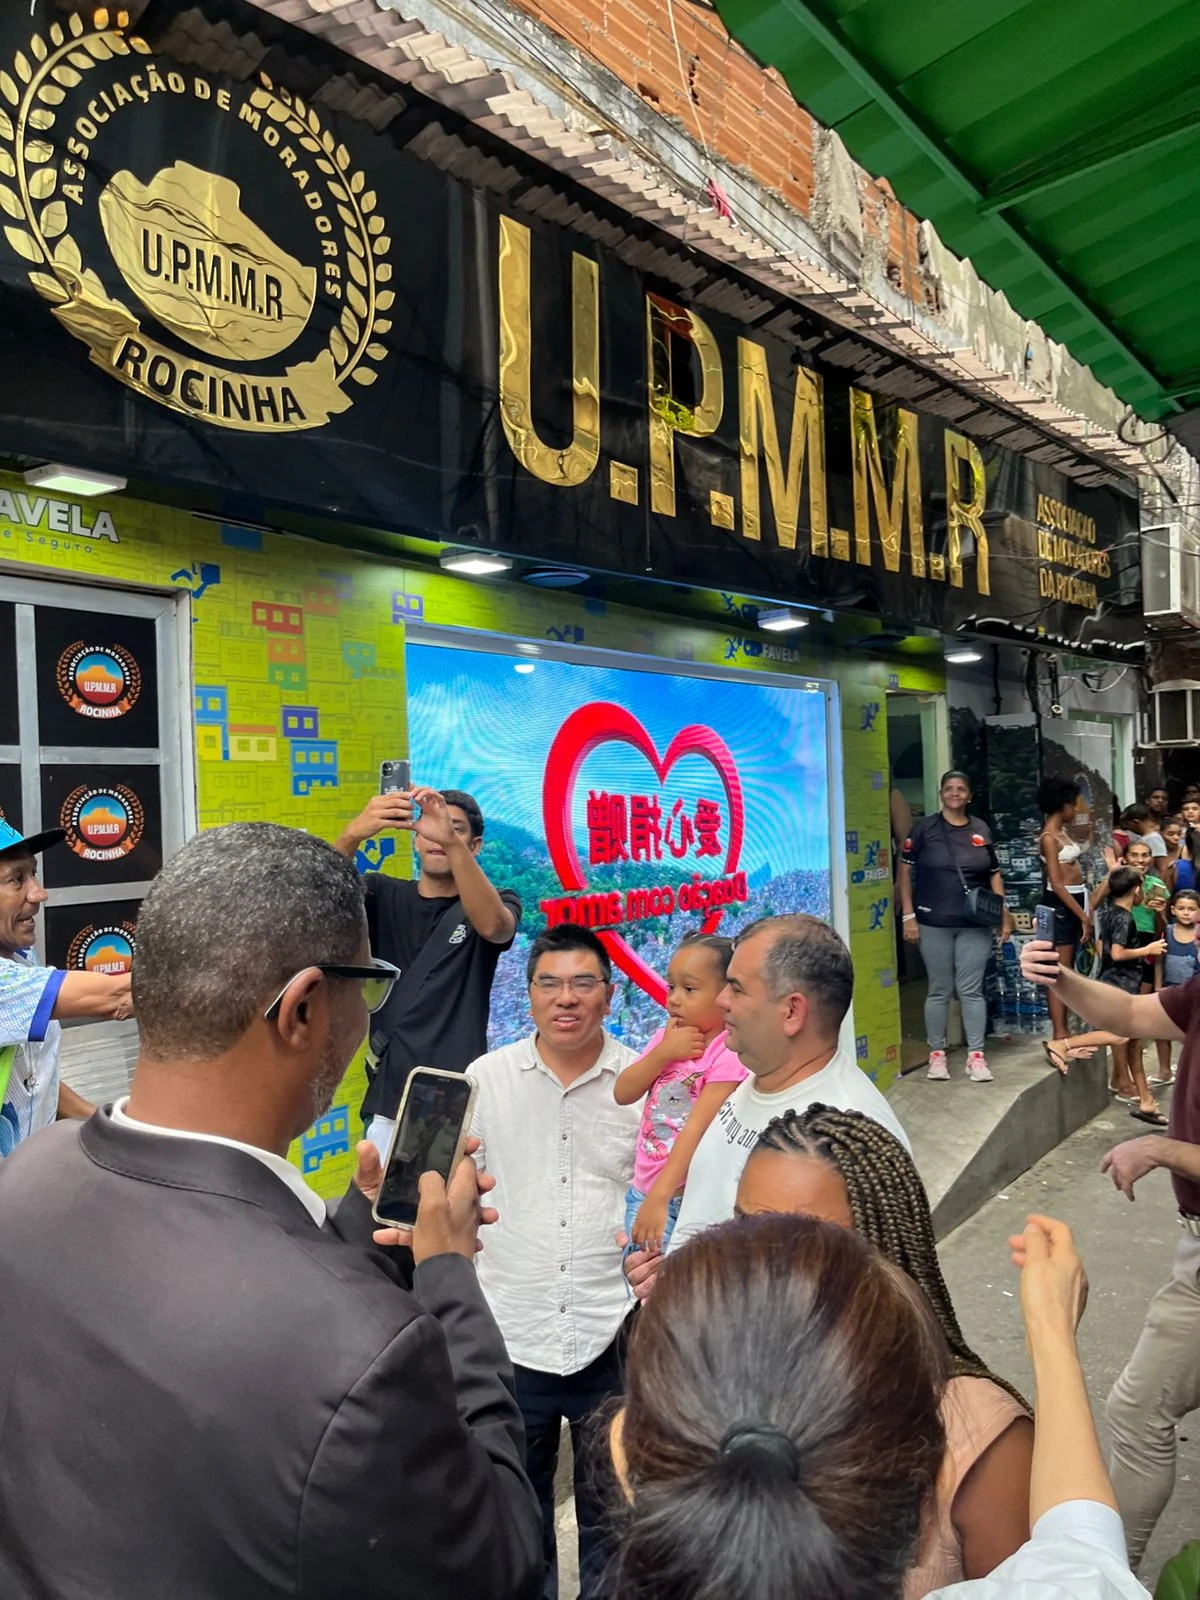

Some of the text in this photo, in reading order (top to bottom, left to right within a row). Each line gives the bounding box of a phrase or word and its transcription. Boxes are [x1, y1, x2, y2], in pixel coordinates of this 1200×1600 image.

[61, 64, 342, 300] ASSOCIAÇÃO DE MORADORES
[142, 228, 284, 321] U.P.M.M.R
[115, 337, 307, 423] ROCINHA
[498, 213, 991, 597] U.P.M.M.R
[26, 531, 93, 554] Seguro
[80, 704, 122, 718] ROCINHA
[83, 846, 126, 861] ROCINHA
